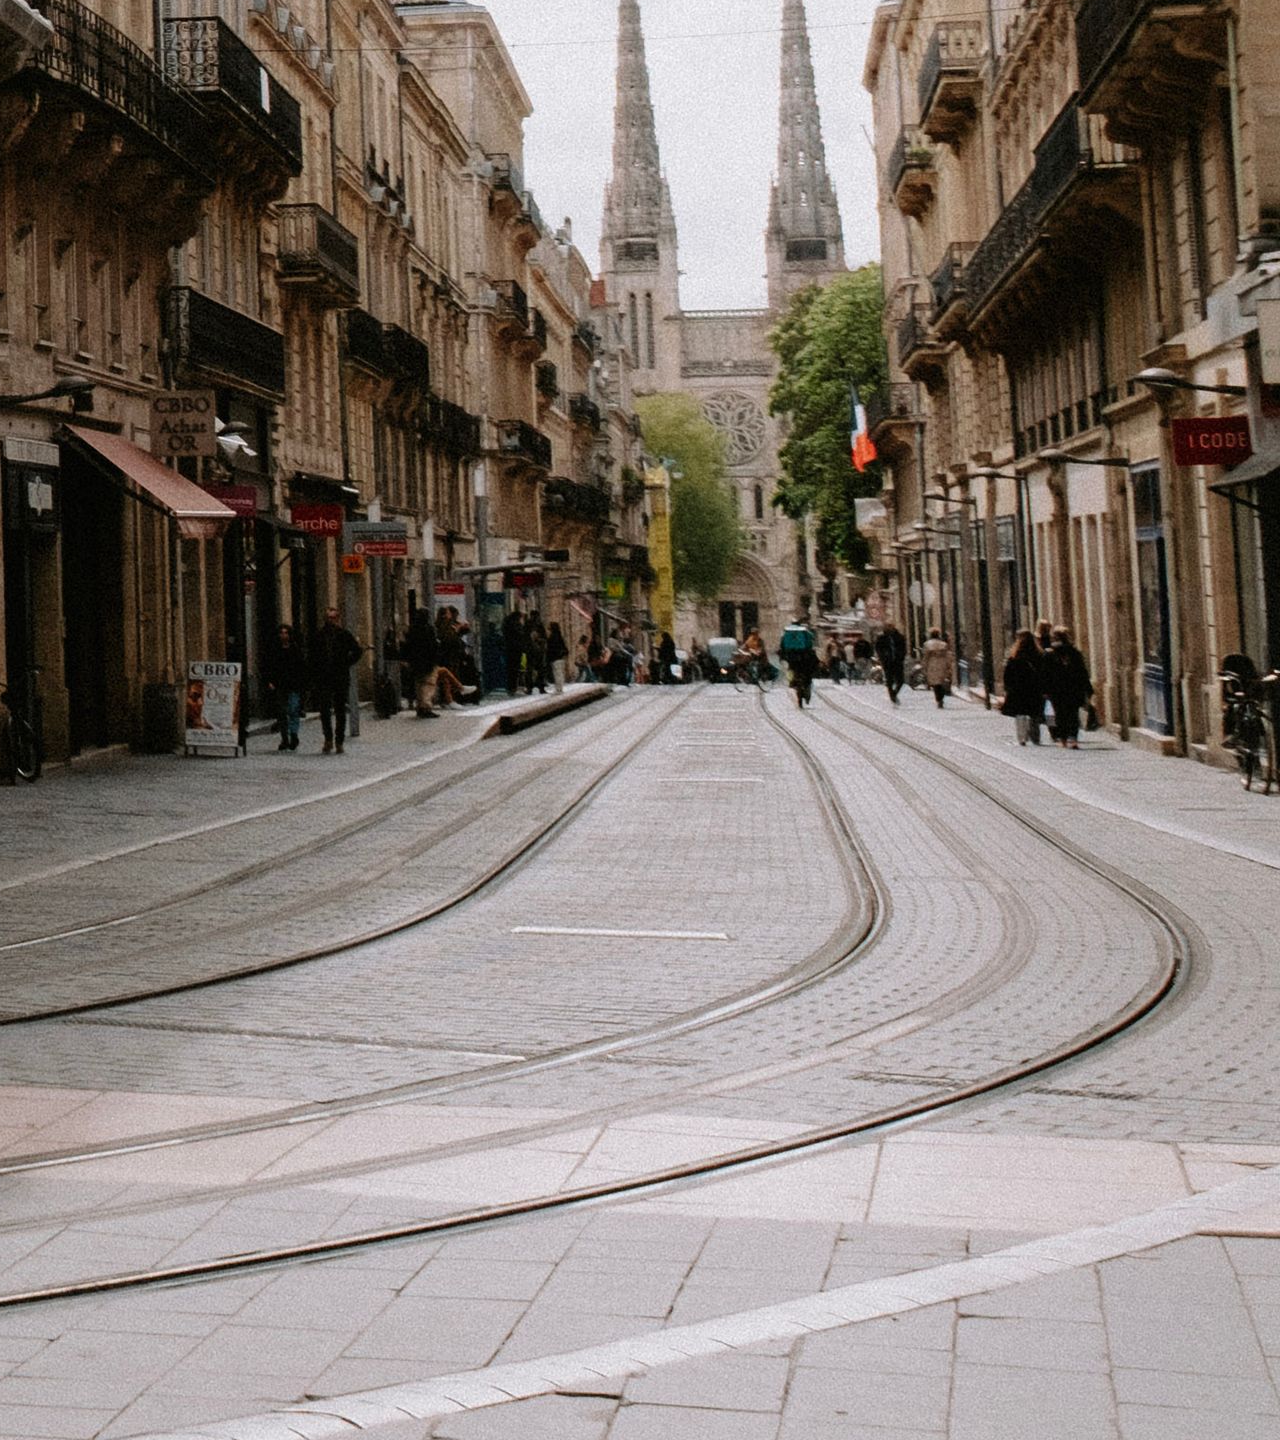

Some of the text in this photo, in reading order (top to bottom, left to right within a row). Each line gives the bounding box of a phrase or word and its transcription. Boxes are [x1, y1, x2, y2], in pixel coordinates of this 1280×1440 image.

[154, 396, 210, 413] CBBO
[159, 418, 208, 434] Achat
[168, 434, 198, 451] OR
[295, 517, 338, 530] arche
[191, 663, 238, 676] CBBO
